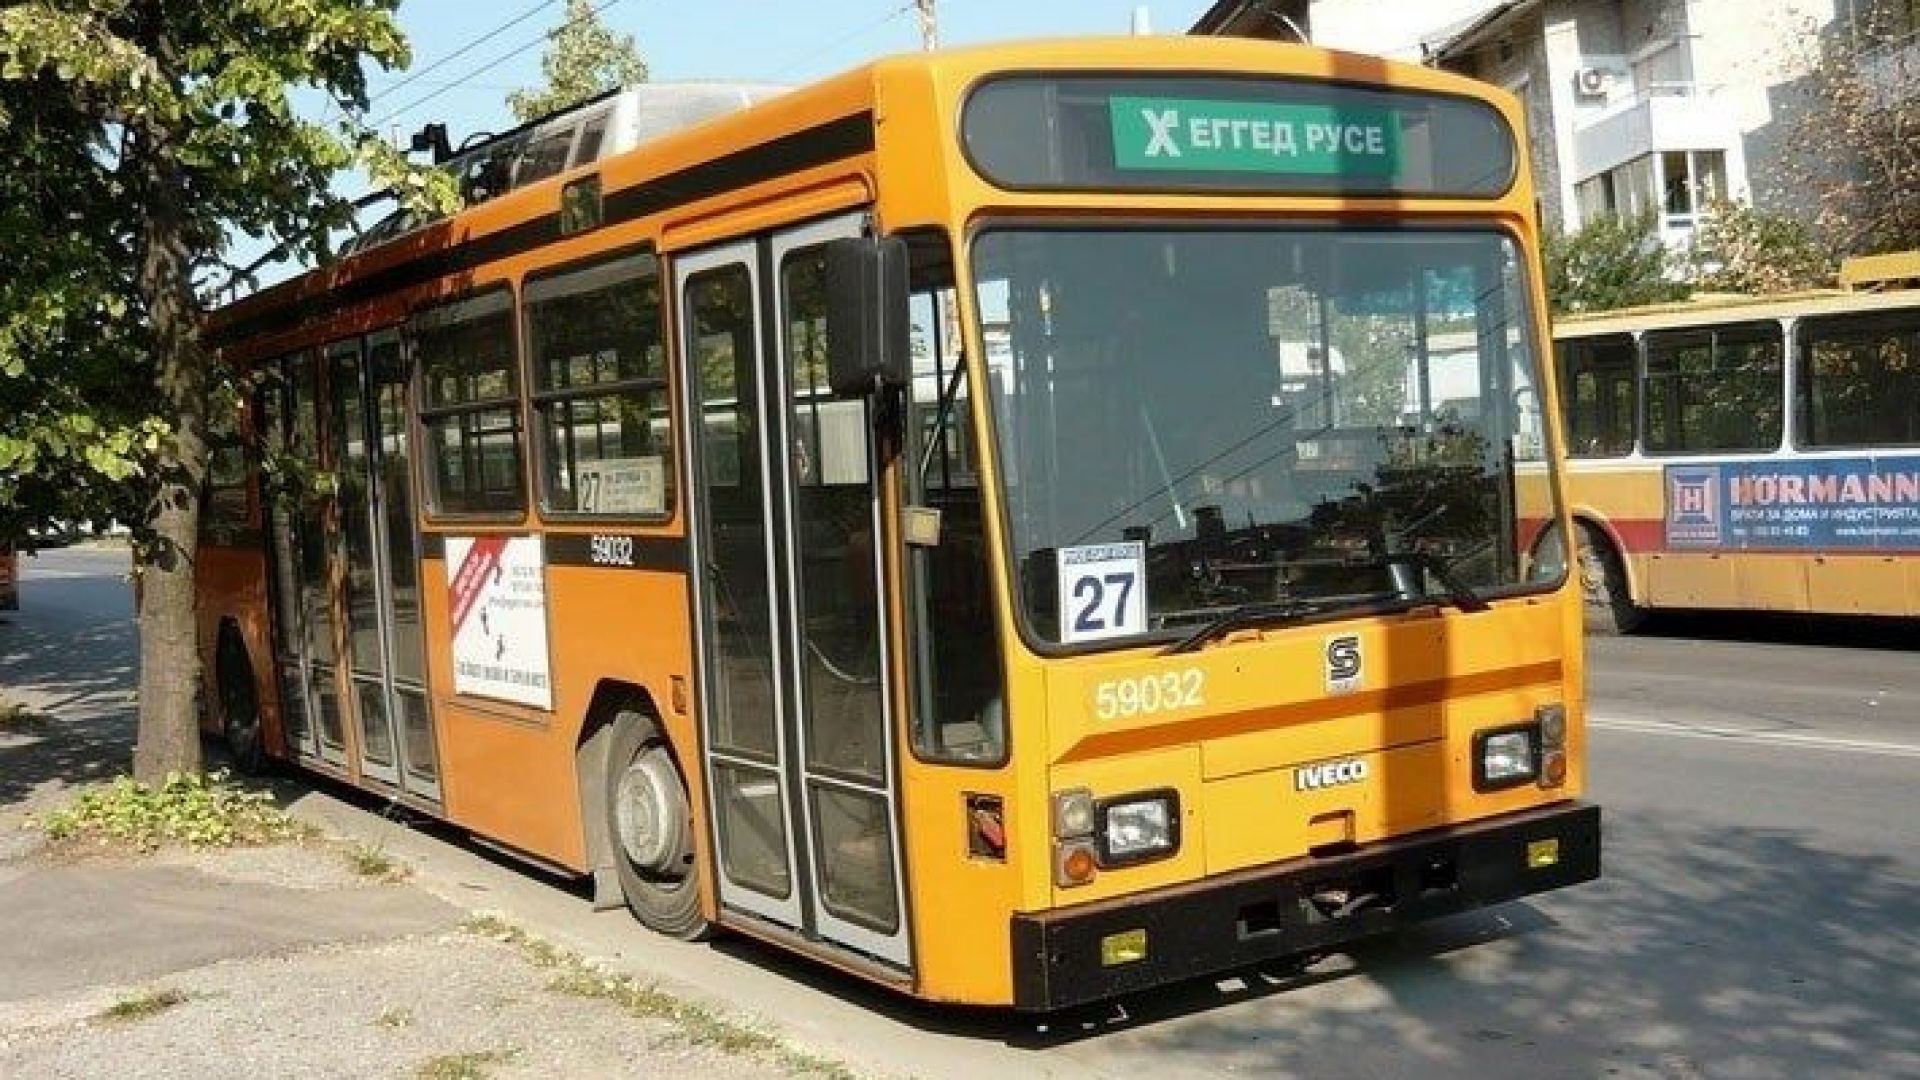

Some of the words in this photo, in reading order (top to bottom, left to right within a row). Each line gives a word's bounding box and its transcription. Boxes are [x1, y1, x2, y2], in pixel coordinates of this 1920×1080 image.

[1189, 118, 1297, 156] ЕГГЕД
[1306, 123, 1386, 155] РУСЕ
[591, 534, 635, 565] 59032
[1073, 571, 1135, 632] 27
[1096, 667, 1205, 719] 59032
[1294, 757, 1367, 791] IVECO
